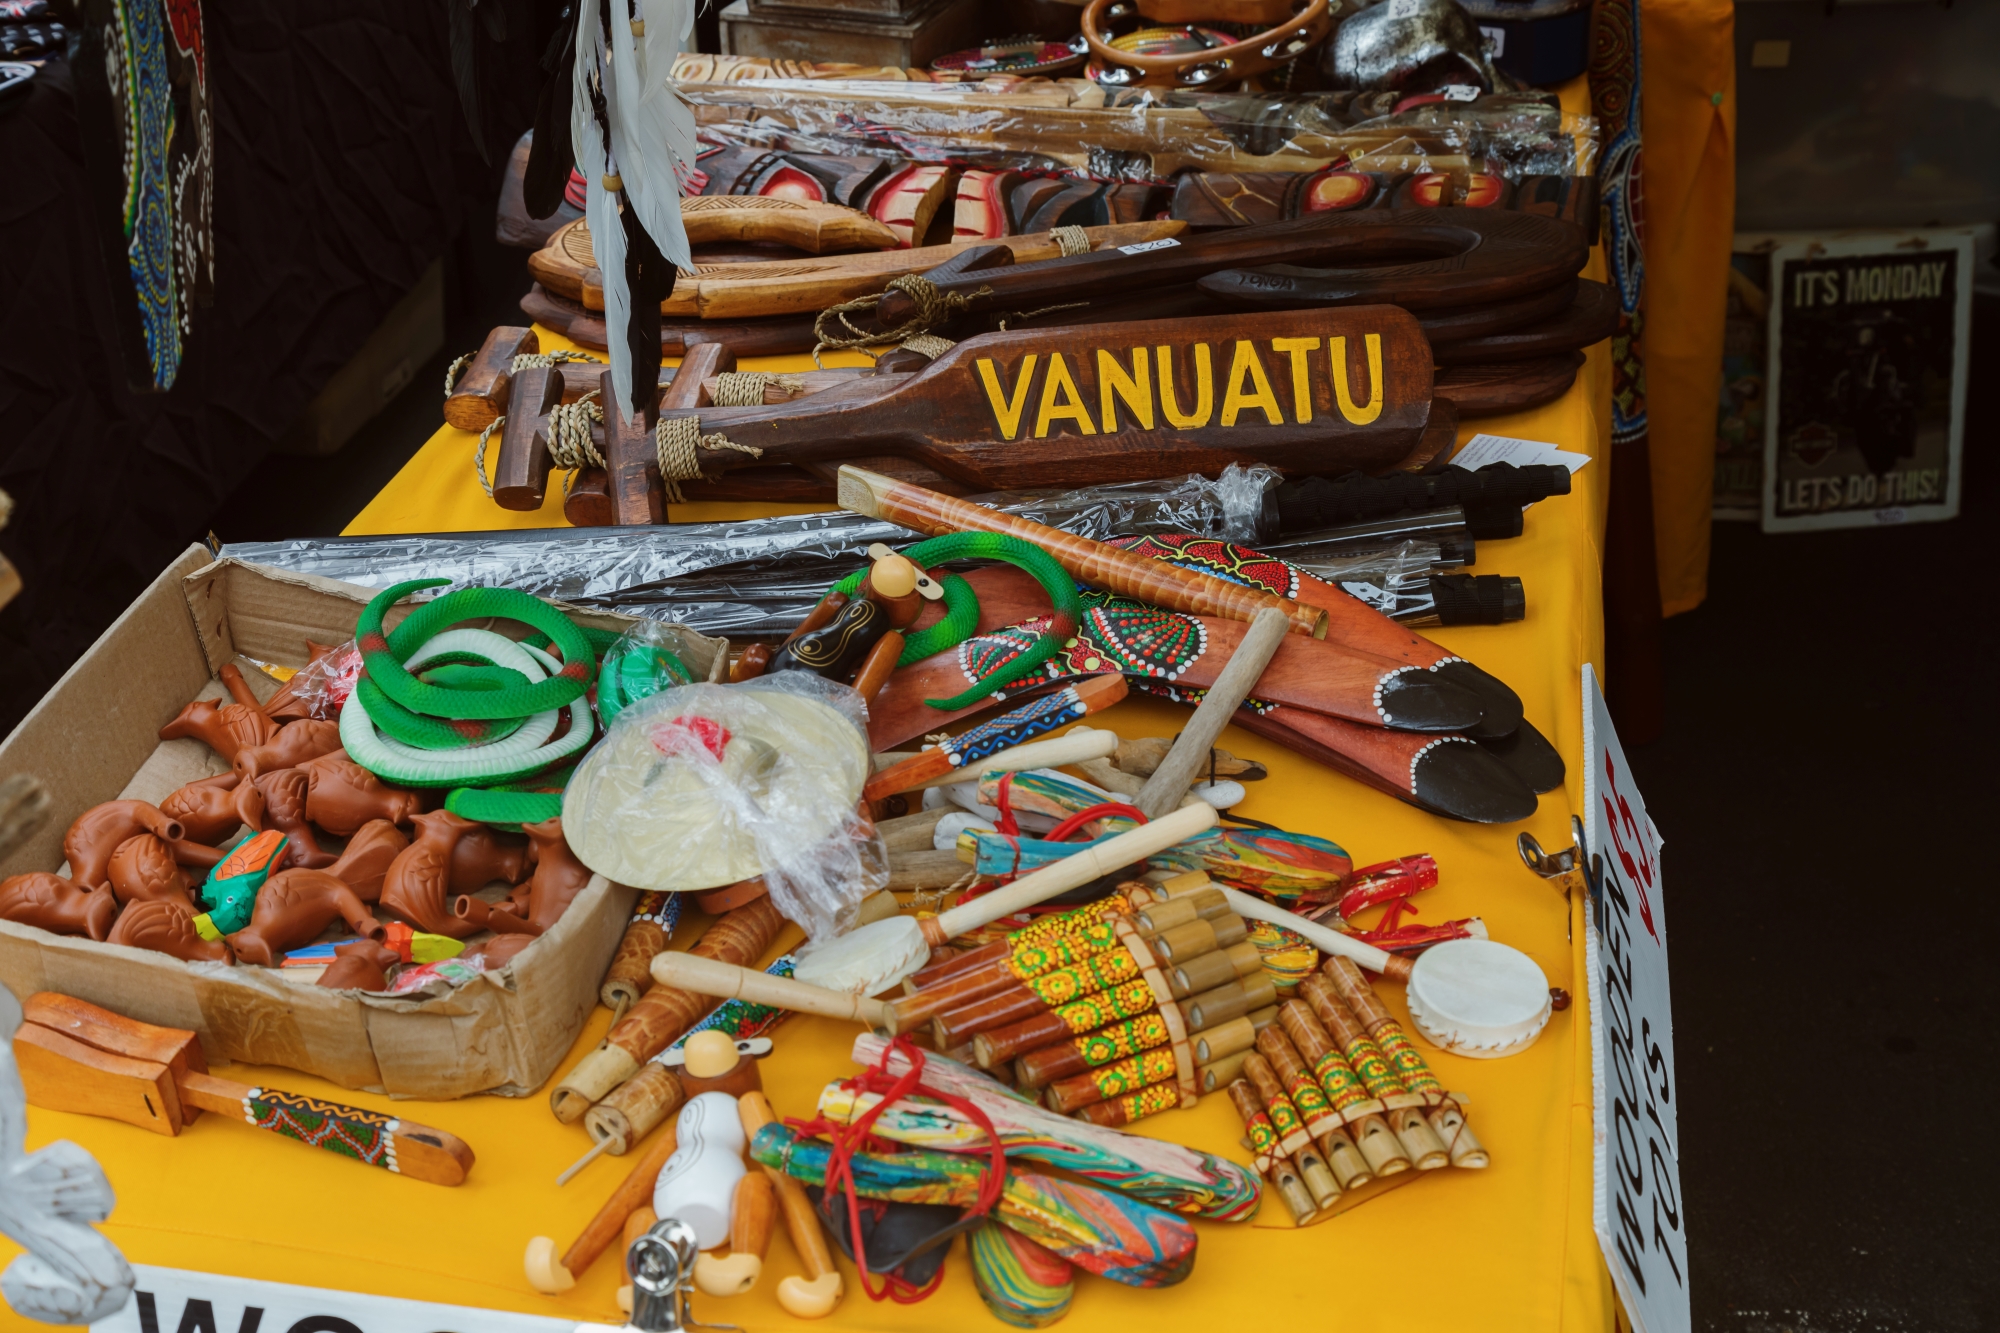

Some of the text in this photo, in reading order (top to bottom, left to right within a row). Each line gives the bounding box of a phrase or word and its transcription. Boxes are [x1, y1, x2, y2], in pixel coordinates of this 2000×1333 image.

[1238, 273, 1293, 290] TONGA
[1845, 260, 1948, 305] MONDAY
[976, 333, 1384, 440] VANUATU
[1847, 472, 1878, 505] DO
[1884, 467, 1940, 502] THIS!
[1604, 843, 1646, 1298] WOODEN
[1640, 1016, 1682, 1289] TOYS
